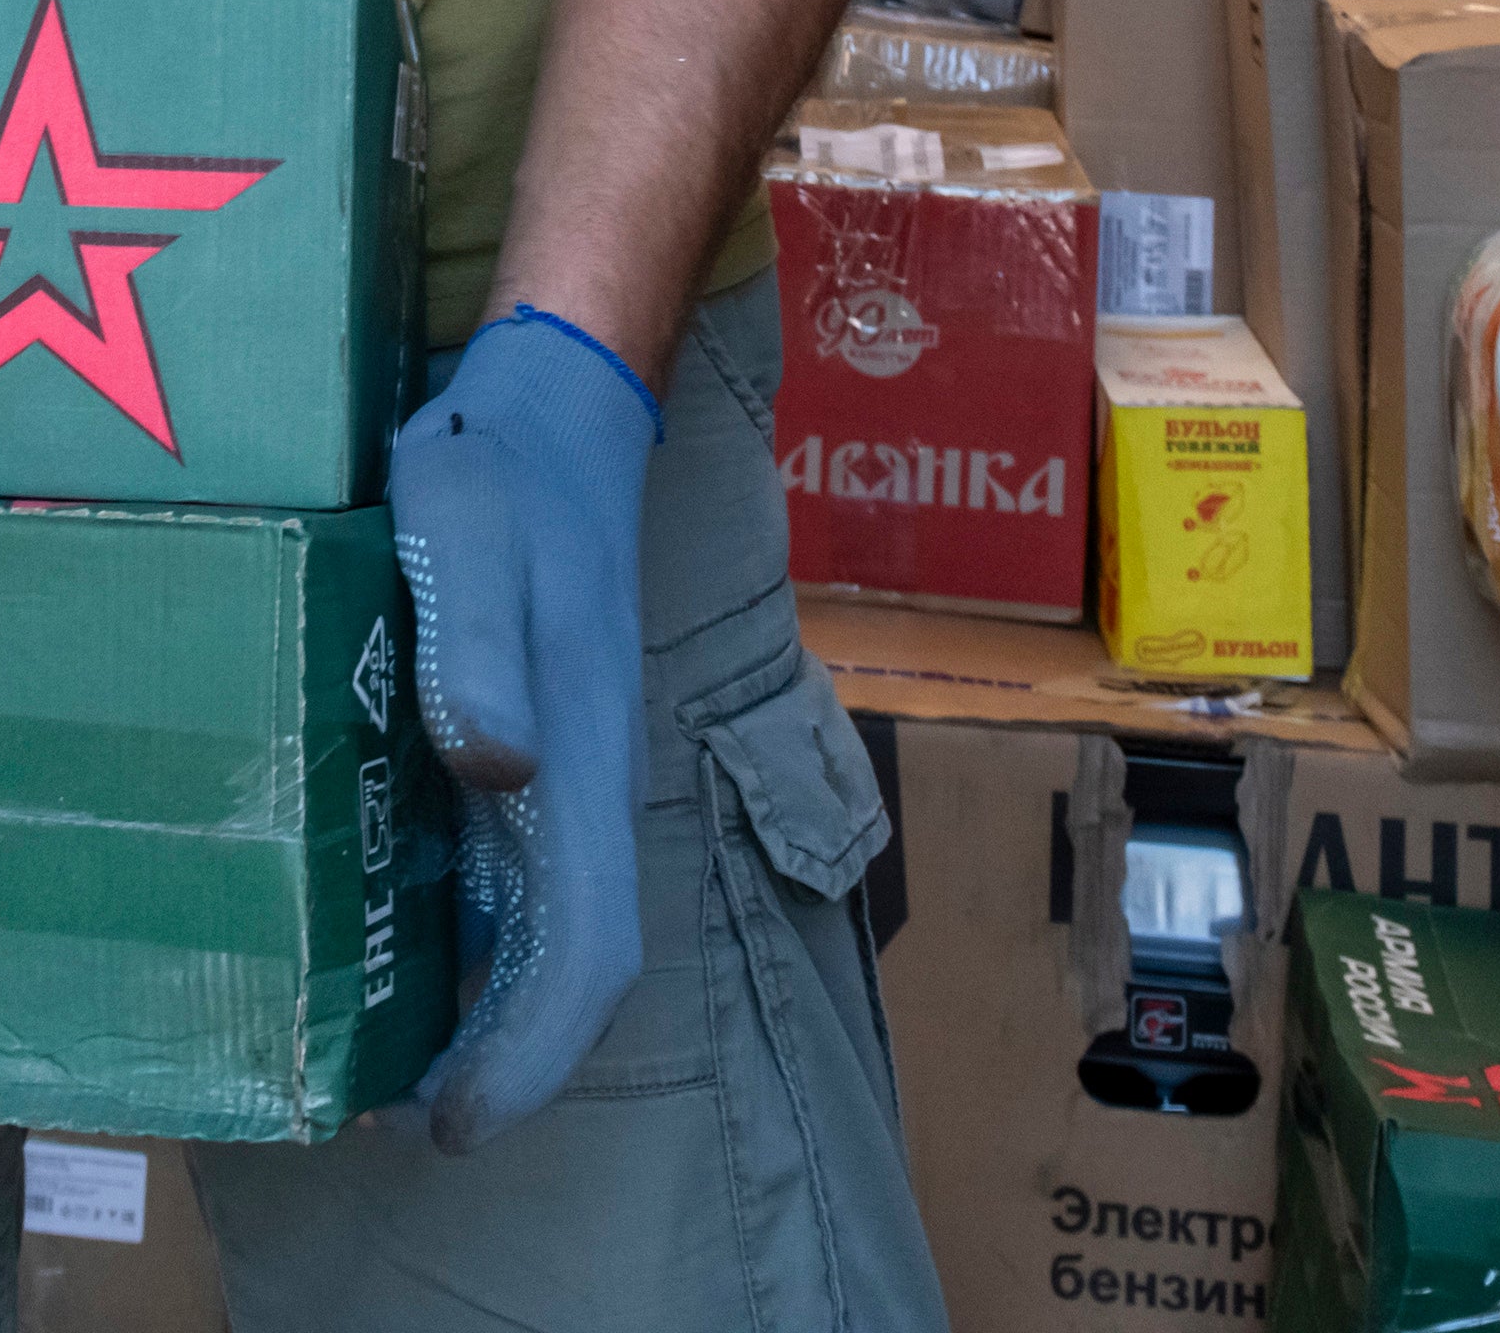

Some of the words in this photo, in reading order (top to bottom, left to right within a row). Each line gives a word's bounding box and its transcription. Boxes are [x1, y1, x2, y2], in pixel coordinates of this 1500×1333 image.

[1165, 419, 1261, 440] БУЛЬОН
[1166, 439, 1261, 455] ГОВЯЖИЙ
[1212, 639, 1300, 660] БУЛЬОН
[1370, 913, 1435, 1016] АРМИЯ
[1050, 1185, 1276, 1263] Электр
